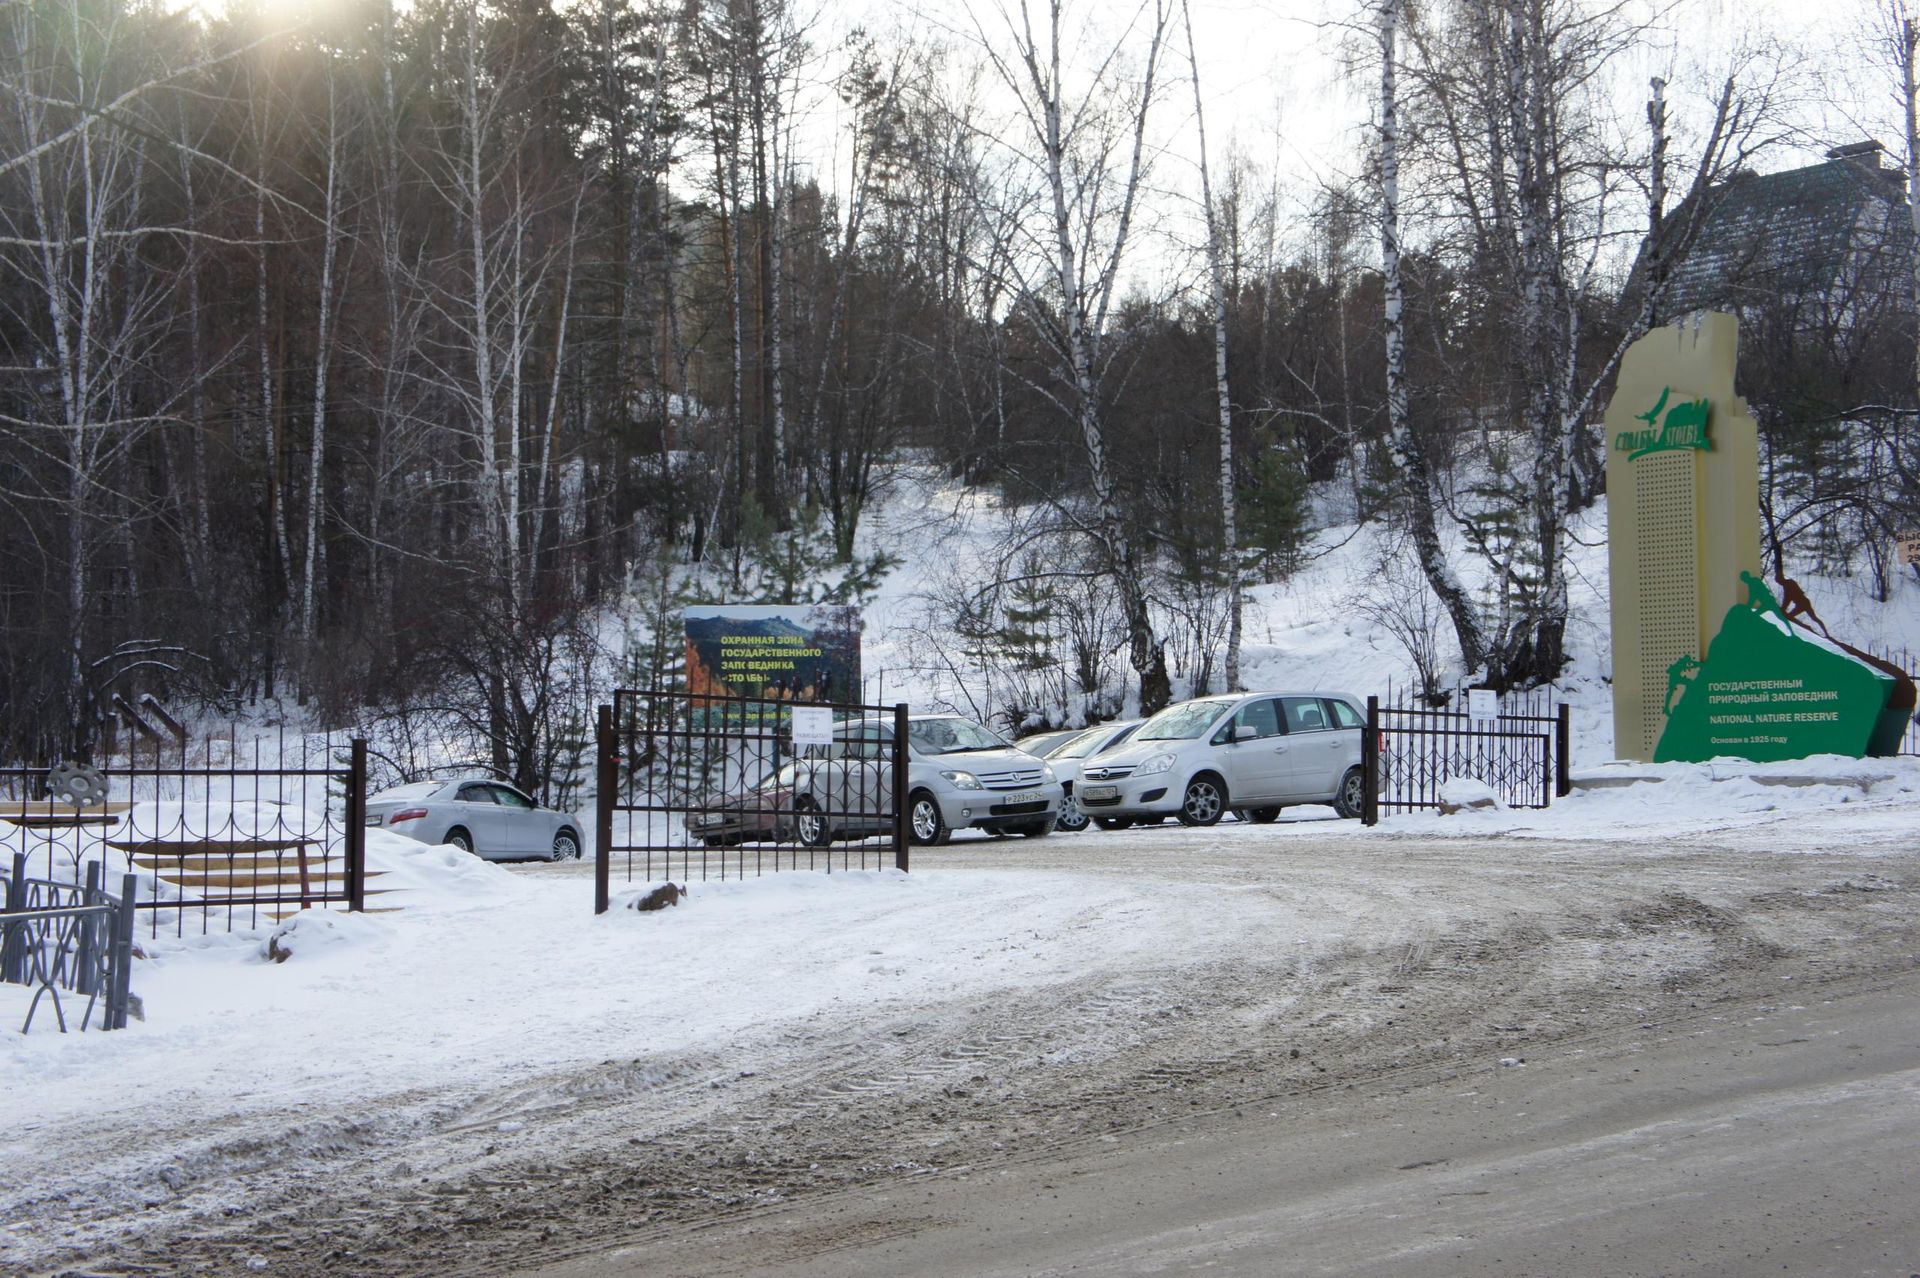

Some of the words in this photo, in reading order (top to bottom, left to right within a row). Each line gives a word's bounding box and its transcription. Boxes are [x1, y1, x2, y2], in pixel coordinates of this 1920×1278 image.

[721, 636, 775, 645] ОХРАННАЯ
[776, 636, 804, 645] ЗОНА
[721, 648, 822, 658] ГОСУДАРСТВЕННОГО
[1708, 692, 1769, 705] ПРИРОДНЫЙ
[1771, 691, 1839, 703] ЗАПОВЕДНИК
[1710, 714, 1754, 724] NATIONAL
[1755, 713, 1792, 723] NATURE
[1794, 712, 1839, 722] RESERVE
[1710, 736, 1743, 744] Основан
[1750, 735, 1769, 743] 1925
[1770, 736, 1788, 745] году
